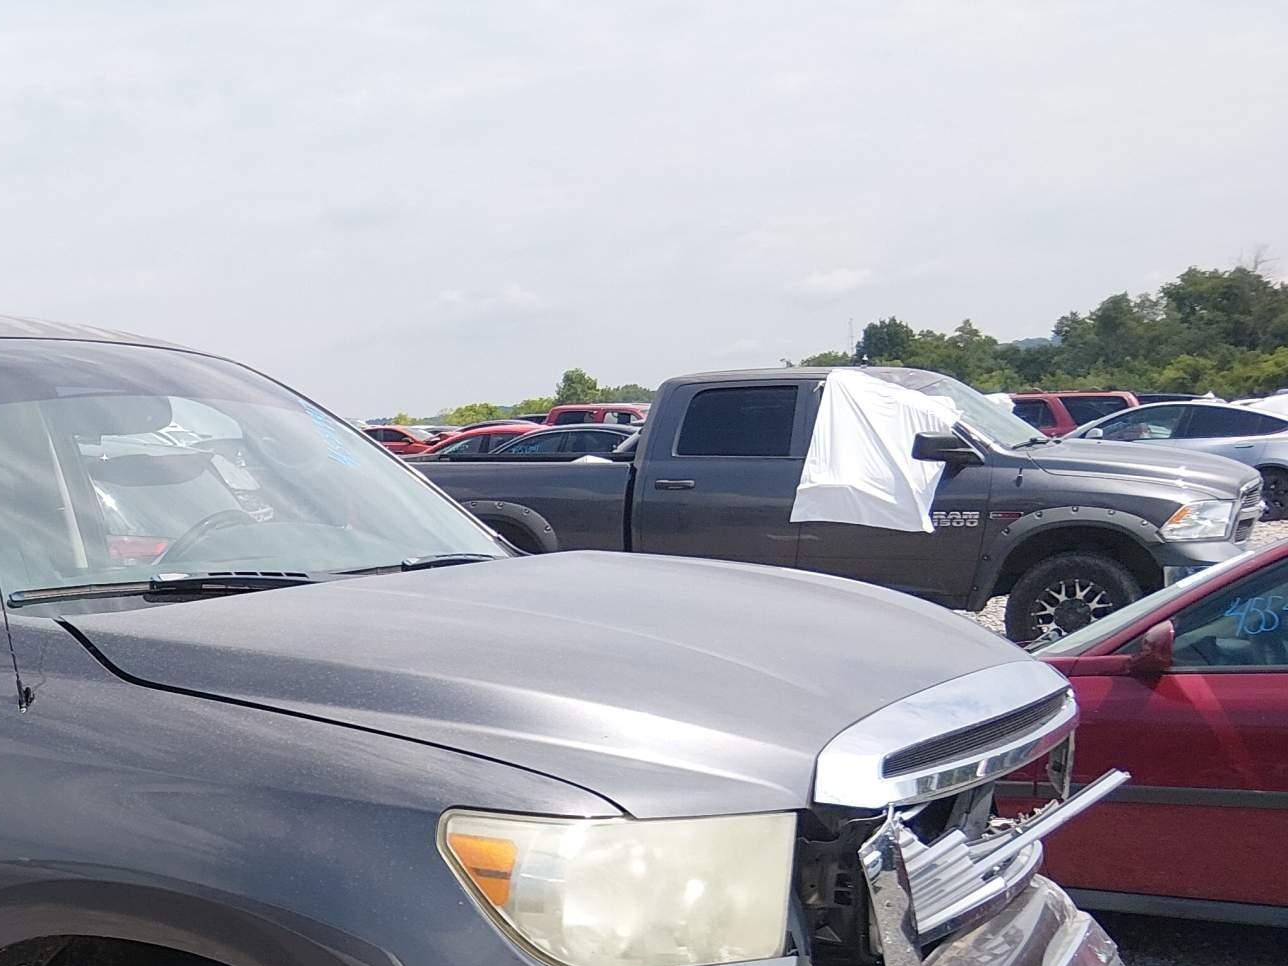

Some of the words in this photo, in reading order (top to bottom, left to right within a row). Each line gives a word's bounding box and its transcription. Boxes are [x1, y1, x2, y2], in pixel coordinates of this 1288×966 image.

[932, 511, 980, 519] RAM
[932, 519, 979, 527] 1500
[1223, 595, 1288, 637] 455
